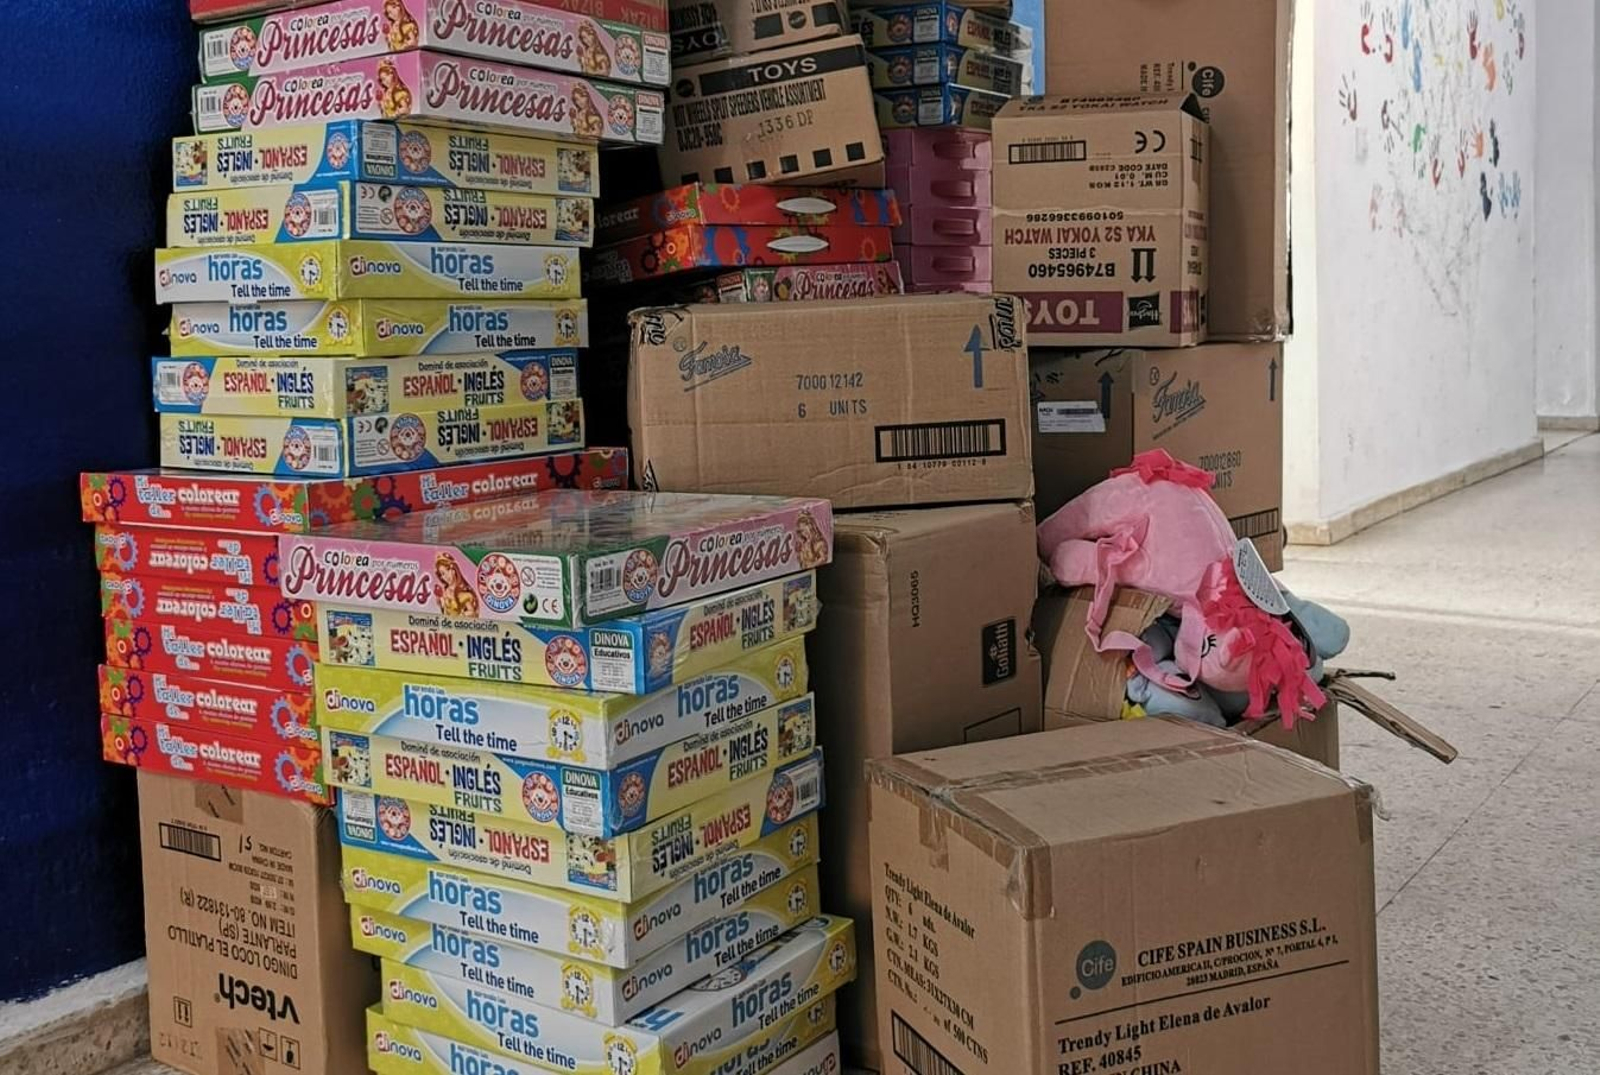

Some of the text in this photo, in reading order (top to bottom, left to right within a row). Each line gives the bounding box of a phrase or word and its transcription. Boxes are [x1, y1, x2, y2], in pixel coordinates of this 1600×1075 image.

[257, 15, 379, 67] Princesas
[434, 0, 574, 59] Princesas
[748, 58, 817, 82] TOYS
[251, 79, 373, 126] Princesas
[427, 62, 566, 121] Princesas
[218, 135, 252, 150] FRUITS
[449, 135, 489, 149] FRUITS
[217, 146, 307, 178] ESPAÑOL INGLÉS
[449, 151, 546, 178] ESPAÑOL INGLÉS
[1005, 226, 1156, 245] YKA S2 YOKAI WATCH
[431, 247, 494, 276] horas
[1050, 247, 1095, 259] 3 PIECES
[459, 278, 523, 291] Tell the time
[1029, 263, 1115, 278] B74965460
[231, 283, 291, 298] Tell the time
[794, 271, 874, 300] Princesas
[229, 306, 287, 332] horas
[449, 307, 509, 332] horas
[678, 341, 752, 382] Famosa
[224, 369, 270, 393] ESPAÑOL
[403, 366, 504, 397] ESPAÑOL INGLÉS
[278, 395, 314, 409] FRUITS
[798, 399, 867, 418] 6 UNITS
[177, 484, 240, 506] colorear
[472, 472, 538, 493] colorear
[699, 533, 742, 552] colorea
[149, 552, 208, 574] colorear
[324, 550, 370, 568] colorea
[658, 533, 792, 598] Princesas
[286, 546, 430, 605] Princesas
[156, 599, 216, 620] colorear
[409, 616, 439, 627] Dominó
[442, 620, 452, 628] de
[690, 594, 774, 650] ESPAÑOL INGLÉS
[207, 639, 272, 663] colorear
[390, 628, 521, 664] ESPAÑOL INGLÉS
[594, 633, 629, 647] DINOVA
[742, 625, 774, 650] FRUITS
[996, 622, 1009, 678] Goliath
[469, 662, 522, 680] FRUITS
[196, 690, 257, 714] colorear
[325, 690, 375, 713] dinova
[404, 685, 478, 724] horas
[677, 675, 740, 718] horas
[704, 694, 767, 728] Tell the time
[435, 724, 517, 752] Tell the time
[200, 741, 261, 768] colorear
[668, 723, 768, 789] ESPAÑOL INGLÉS
[730, 754, 767, 781] FRUITS
[386, 754, 501, 796] ESPAÑOL INGLÉS
[566, 772, 597, 788] DINOVA
[454, 791, 502, 813] FRUITS
[701, 804, 751, 848] ESPAÑOL
[485, 829, 550, 863] ESPAÑOL
[429, 870, 501, 914] horas
[196, 894, 246, 923] 80-131822
[218, 919, 297, 959] PARLANTE (SP)
[270, 918, 296, 938] ITEM
[360, 916, 407, 944] dinova
[459, 911, 539, 944] Tell the time
[168, 925, 297, 979] DINGO LOCO EL PLATILLO
[923, 934, 939, 958] KGS
[1137, 917, 1326, 968] CIFE SPAIN BUSINESS S.L.
[924, 956, 939, 980] KGS
[1081, 955, 1114, 978] Cife
[219, 973, 300, 1025] vtech
[390, 980, 437, 1008] dinova
[731, 972, 792, 1028] horas
[467, 990, 539, 1038] horas
[1058, 996, 1271, 1055] Trendy Light Elena de Avalor
[966, 1031, 988, 1065] CTNS
[1058, 1046, 1143, 1075] REF. 40845
